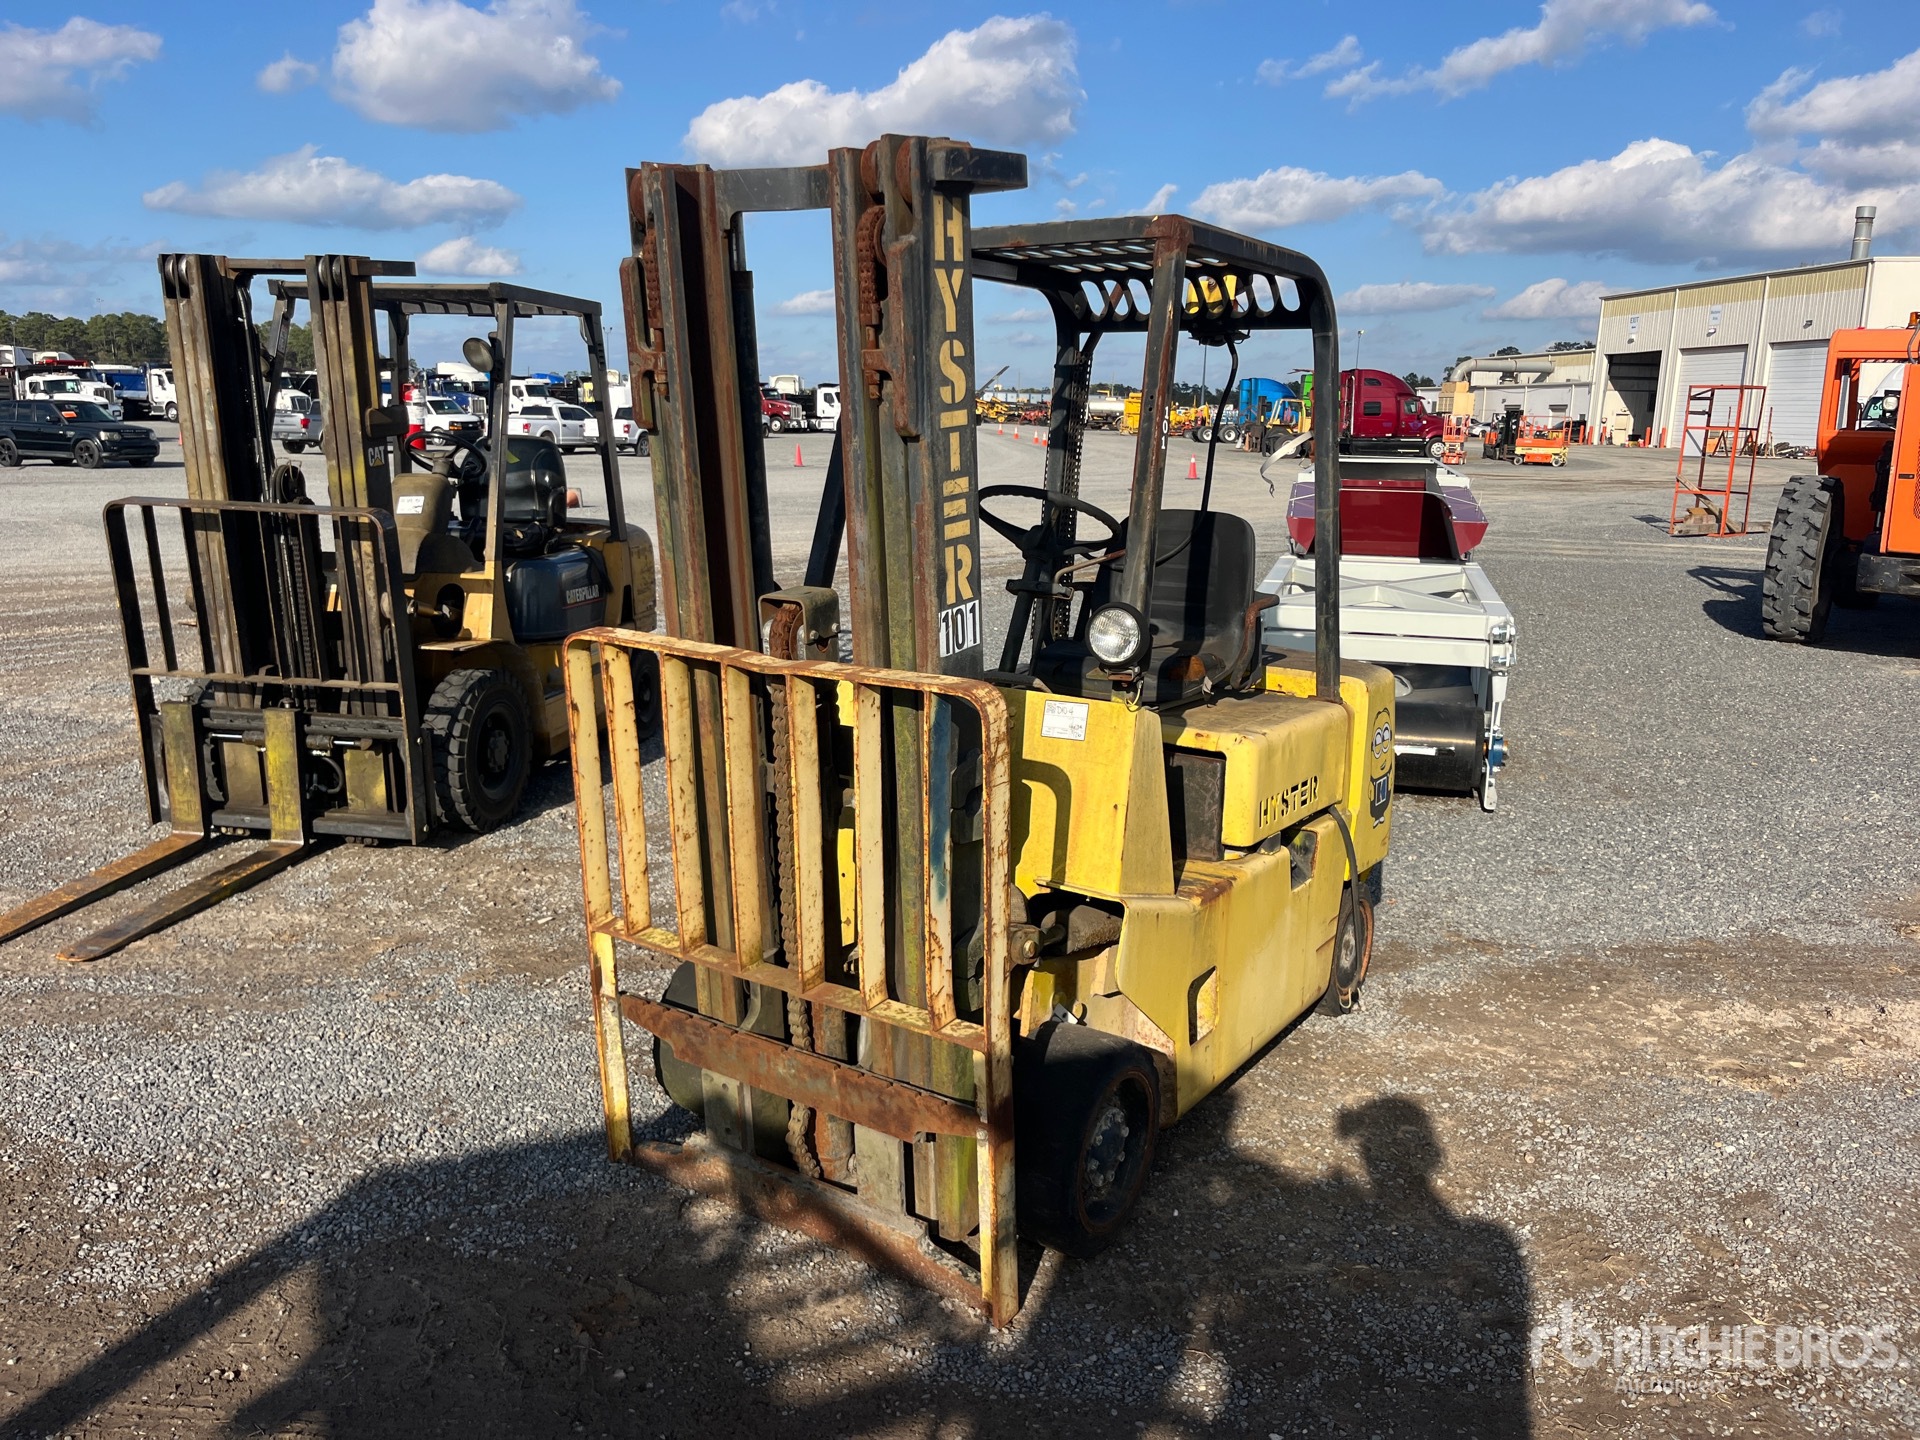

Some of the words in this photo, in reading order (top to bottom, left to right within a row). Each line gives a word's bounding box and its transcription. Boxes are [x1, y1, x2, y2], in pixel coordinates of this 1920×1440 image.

[933, 194, 974, 605] HYSTER
[1161, 405, 1169, 450] 101
[367, 445, 385, 468] CAT
[565, 584, 600, 604] CATERPILLAR
[941, 602, 978, 655] 101
[1258, 775, 1319, 829] HYSTER
